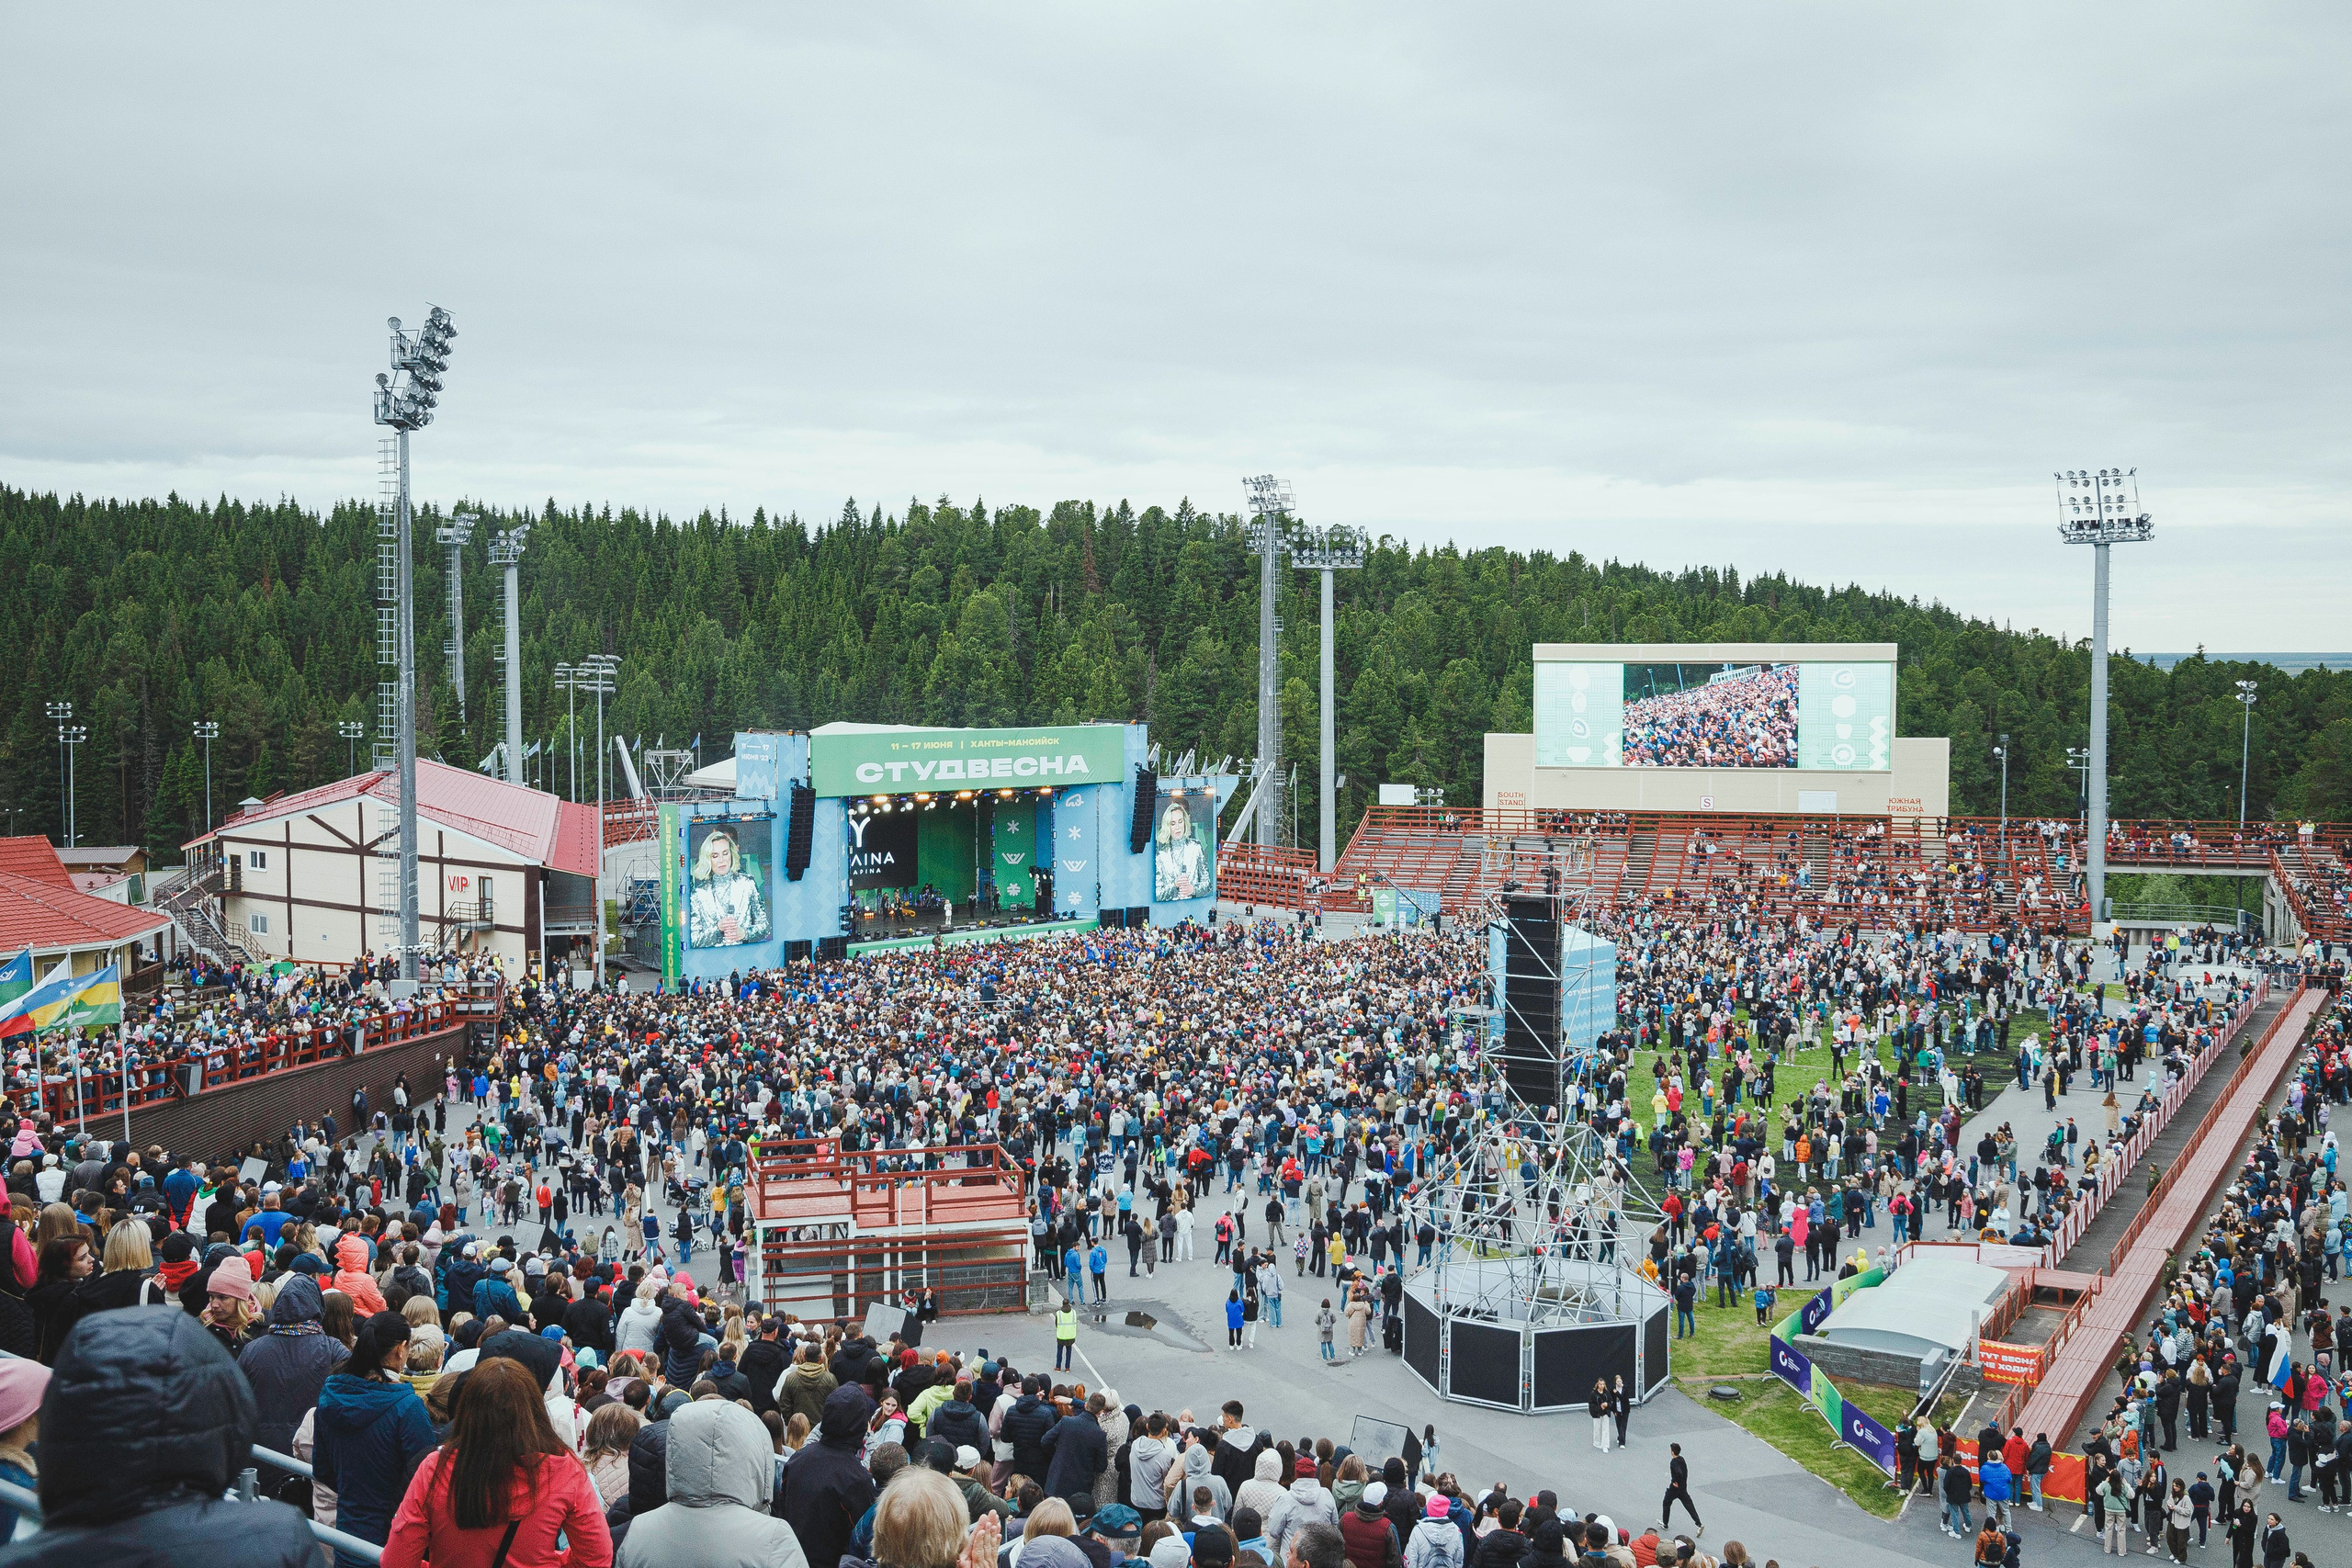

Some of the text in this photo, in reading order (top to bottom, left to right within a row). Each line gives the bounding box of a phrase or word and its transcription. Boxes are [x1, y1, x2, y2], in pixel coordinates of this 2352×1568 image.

[891, 742, 899, 750] 11
[910, 741, 922, 750] 17
[923, 740, 954, 750] ИЮНЯ
[970, 736, 1060, 748] ХАНТЫ-МАНСИЙСК
[855, 754, 1090, 784] СТУДВЕСНА
[1703, 797, 1712, 808] S
[1886, 805, 1925, 813] ТРИБУНА
[665, 813, 673, 928] ОБЪЕДИНЯЕТ
[447, 874, 469, 892] VIP
[1979, 1351, 2038, 1366] ТУТ ВЕСНА
